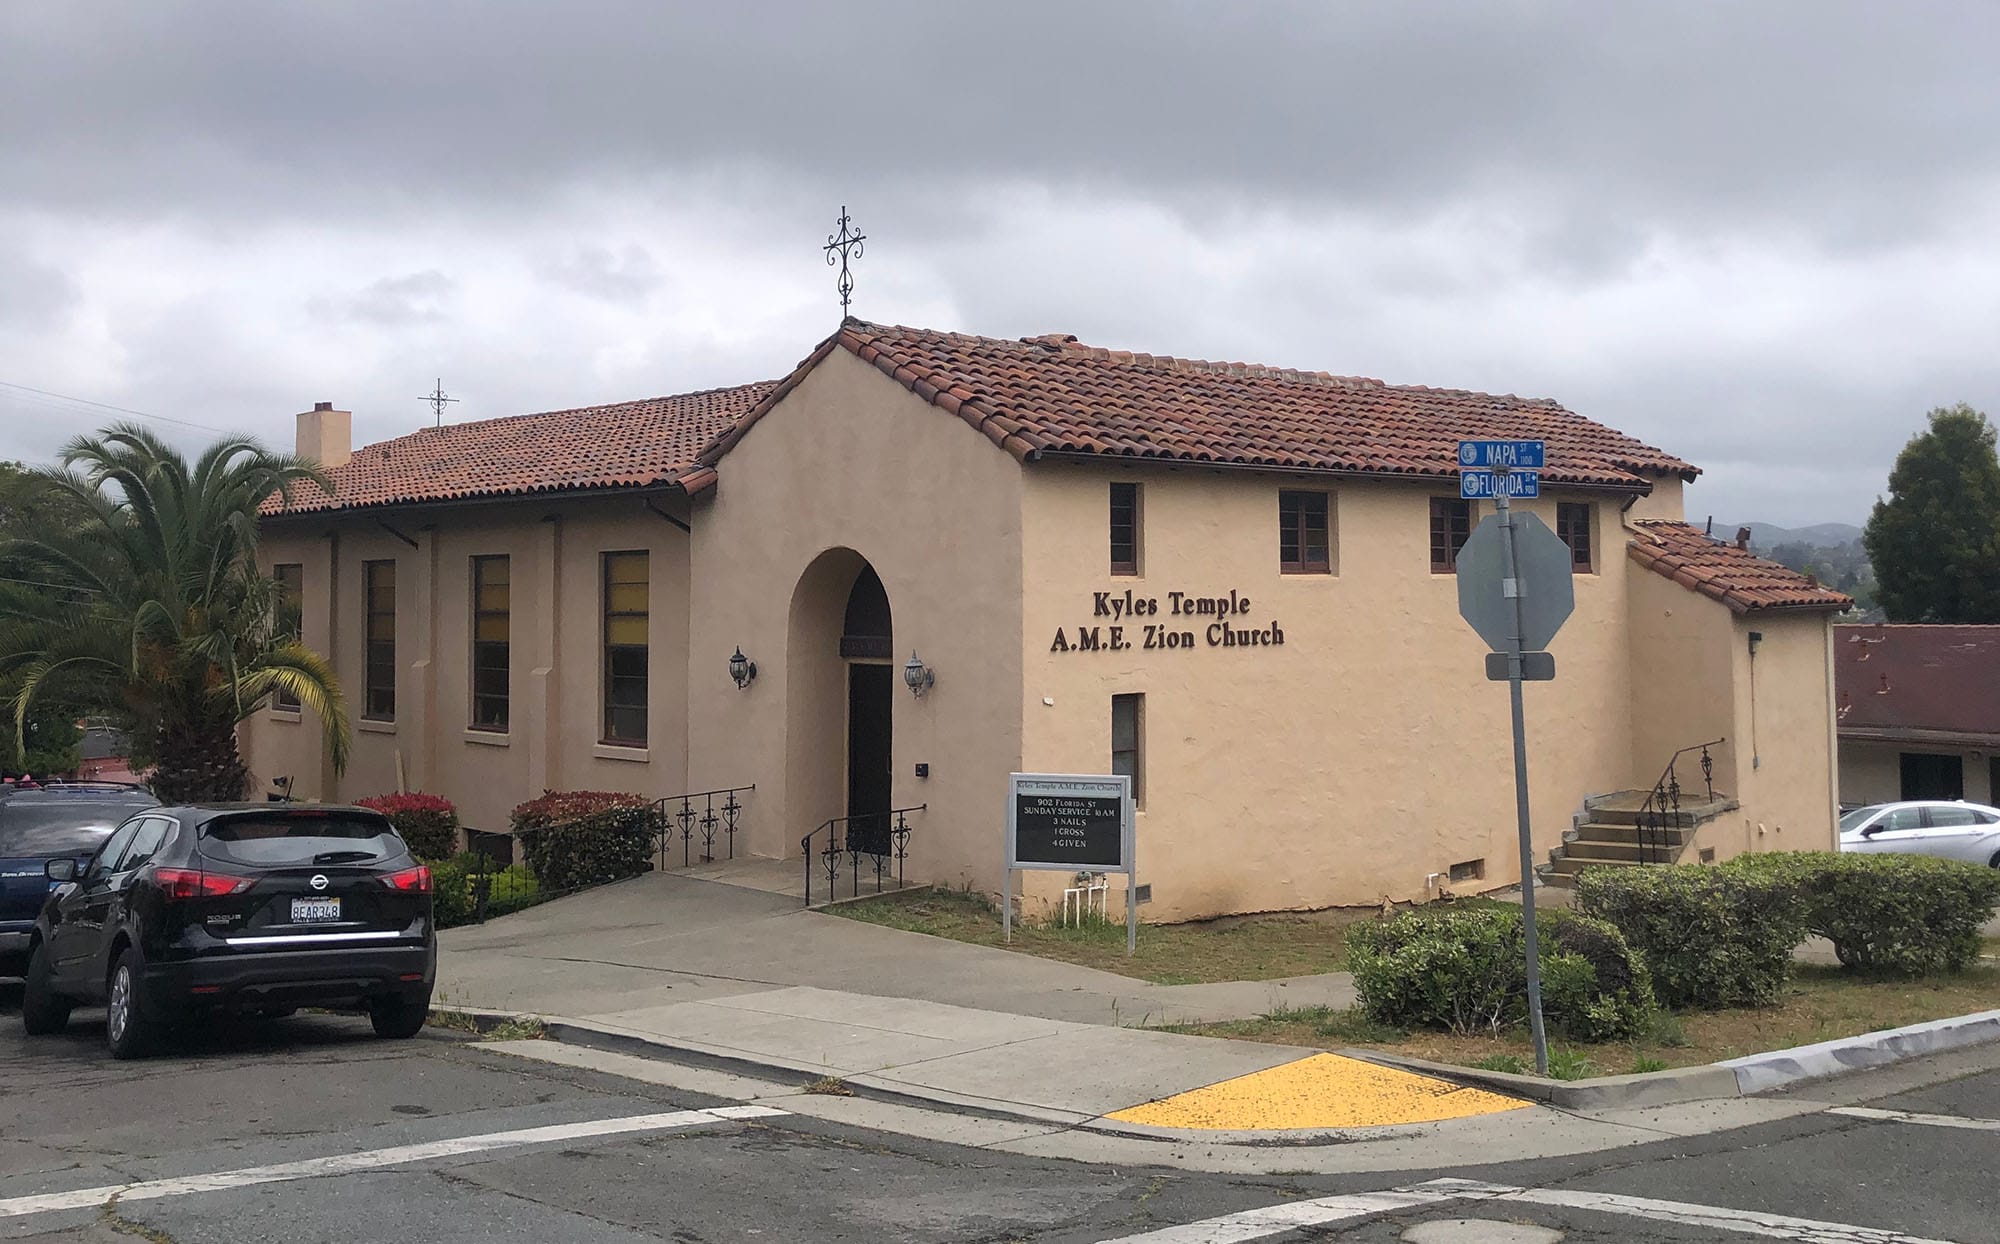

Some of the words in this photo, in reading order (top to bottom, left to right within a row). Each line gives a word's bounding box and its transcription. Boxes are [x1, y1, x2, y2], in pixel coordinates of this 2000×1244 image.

[1486, 444, 1517, 464] NAPA
[1520, 443, 1527, 452] ST
[1520, 455, 1533, 465] 1100
[1479, 474, 1523, 494] FLORIDA
[1093, 589, 1158, 621] Kyles
[1168, 589, 1250, 620] Temple
[1050, 626, 1131, 651] A.M.E.
[1143, 624, 1195, 649] Zion
[1206, 620, 1285, 647] Church
[1096, 784, 1121, 792] Church
[1038, 799, 1053, 807] 902
[1024, 806, 1056, 815] SUNDAY
[1058, 808, 1091, 816] SERVICE
[1102, 809, 1115, 817] AM
[1061, 818, 1087, 827] NAILS
[1058, 828, 1085, 836] CROSS
[1058, 839, 1087, 847] GIVEN
[293, 905, 338, 919] 8EAR348
